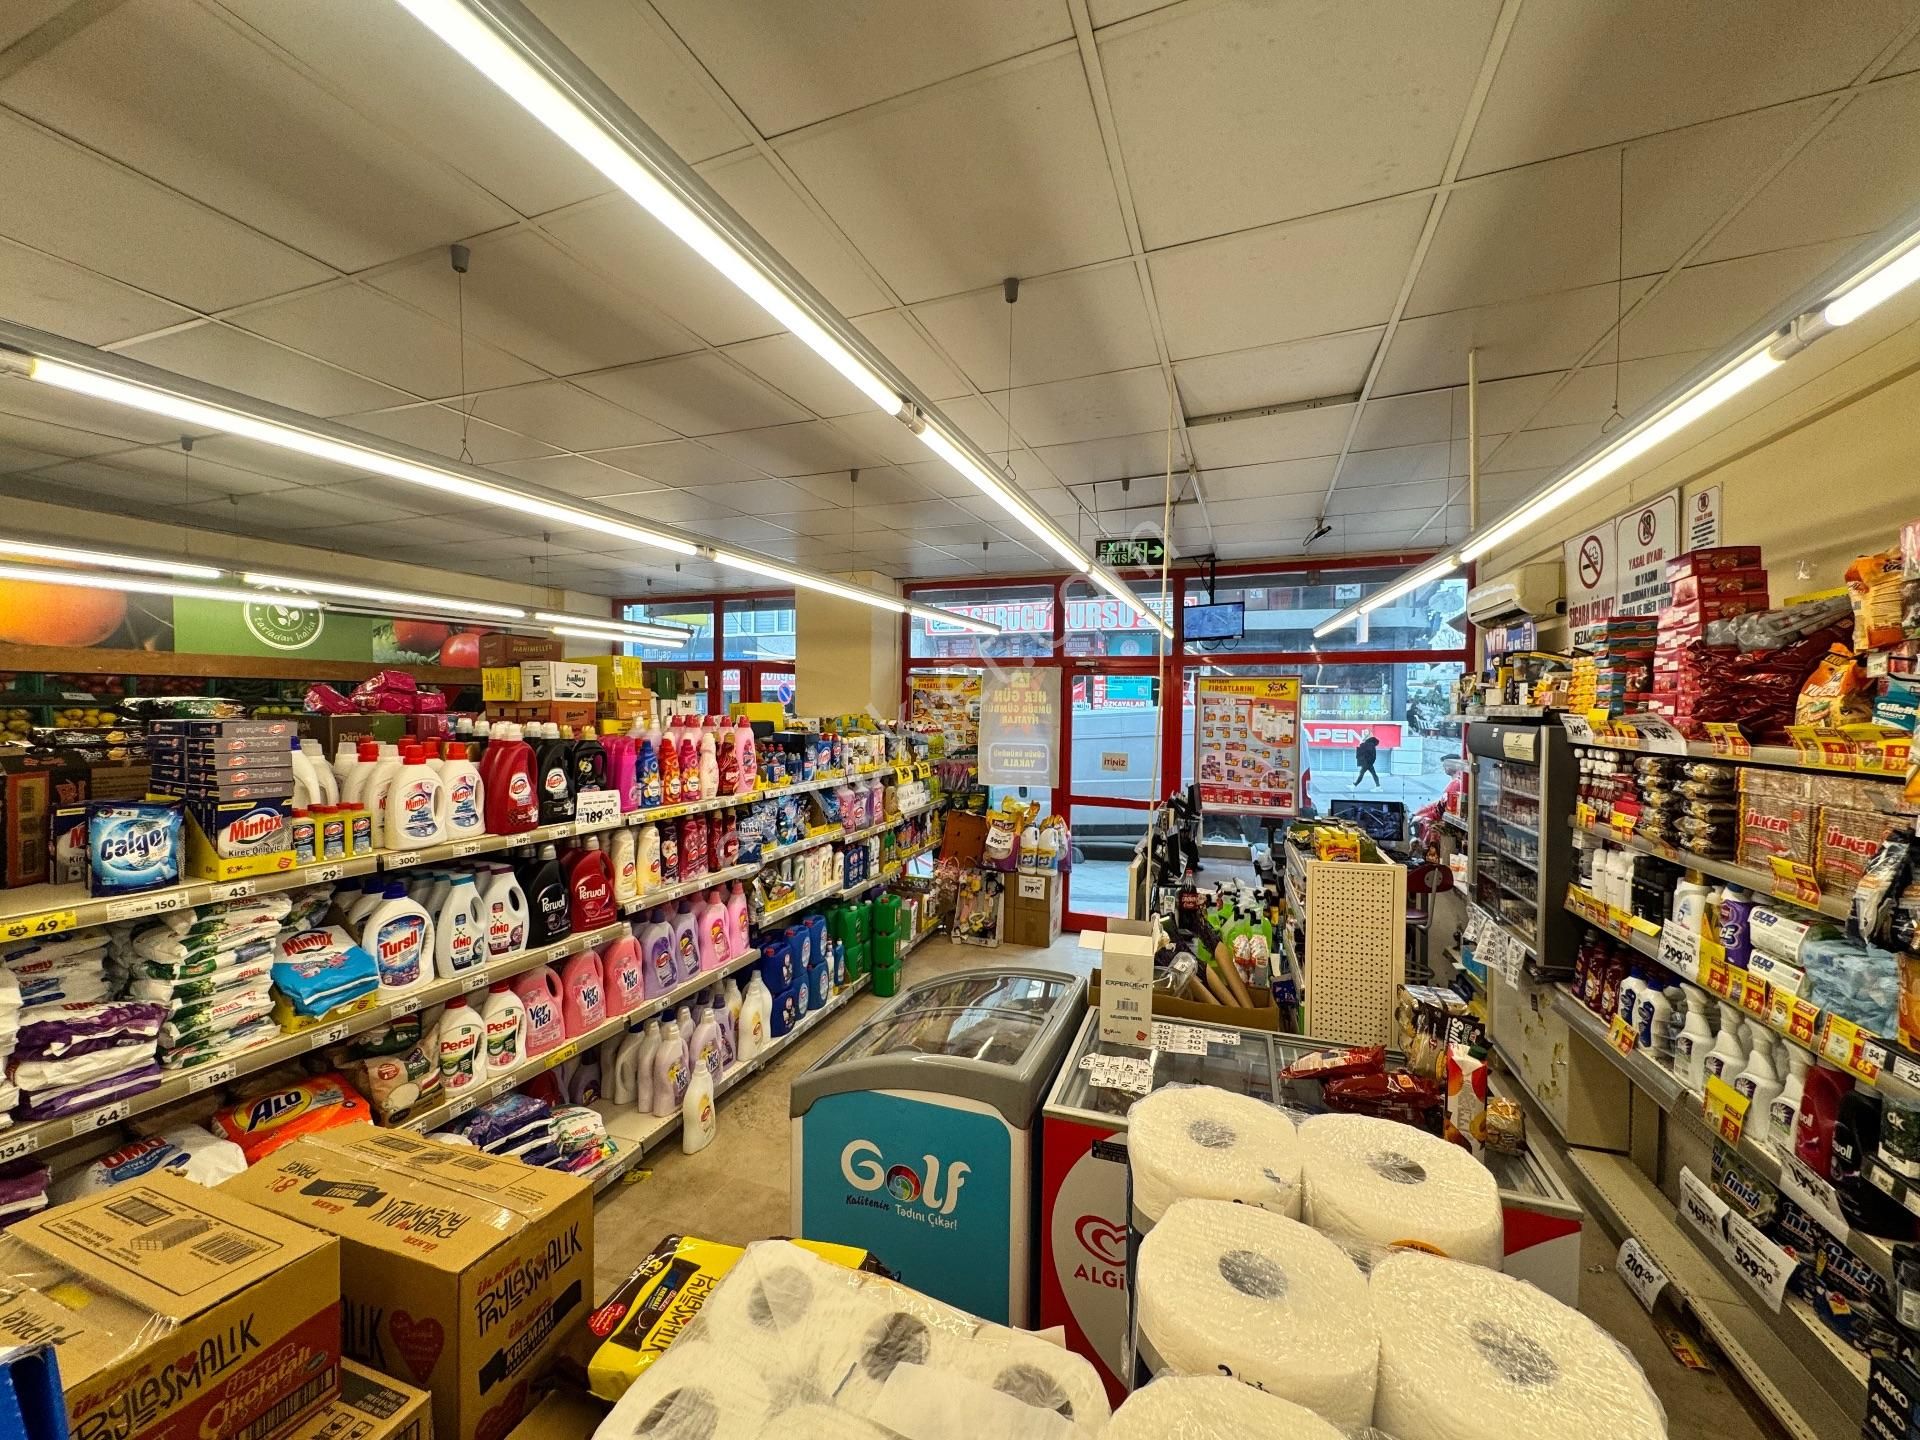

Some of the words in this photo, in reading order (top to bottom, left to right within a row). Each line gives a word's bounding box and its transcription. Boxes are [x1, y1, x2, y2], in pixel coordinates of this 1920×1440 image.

[1100, 541, 1129, 552] EXIT
[1628, 556, 1645, 571] YASAL
[971, 605, 1047, 632] SÜRÜCÜ
[254, 617, 294, 642] tarladan
[297, 621, 316, 640] halka
[566, 674, 586, 687] halley
[229, 815, 283, 843] Mintax
[1746, 808, 1790, 834] ÜLKER
[1826, 825, 1879, 857] ÜLKER
[399, 856, 415, 865] 300
[322, 870, 336, 881] 29
[229, 886, 247, 898] 43
[578, 881, 606, 900] Perwoll
[154, 898, 176, 911] 150
[36, 919, 58, 933] 49
[490, 923, 509, 936] OMO
[1719, 926, 1736, 939] CE
[282, 934, 334, 957] Mintax
[380, 932, 418, 958] Tursil
[453, 936, 471, 949] OMO
[237, 967, 263, 980] ARIEL
[623, 968, 636, 984] Ver
[472, 979, 484, 987] 229
[582, 986, 596, 1000] Ver
[212, 1001, 243, 1015] ARIEL
[405, 1003, 416, 1013] 189
[529, 1003, 548, 1021] Ver
[487, 1016, 517, 1034] Persil
[1795, 1025, 1809, 1040] 90
[329, 1031, 342, 1041] 57
[441, 1034, 475, 1053] Persil
[1868, 1049, 1880, 1061] 54
[1856, 1059, 1874, 1075] 65
[208, 1069, 228, 1084] 134
[246, 1090, 302, 1134] ALO
[460, 1100, 472, 1112] 229
[96, 1110, 120, 1128] 64
[0, 1141, 27, 1160] 134
[101, 1136, 168, 1170] OMO
[841, 1138, 972, 1215] Golf
[1723, 1170, 1762, 1211] finish
[846, 1194, 890, 1211] Kalitenin
[895, 1203, 926, 1222] Tadını
[927, 1212, 958, 1231] Çıkar!
[402, 1235, 439, 1254] ÜLKER
[1073, 1262, 1127, 1291] ALGi
[1873, 1371, 1909, 1409] ARKO
[1871, 1393, 1906, 1432] ARKO
